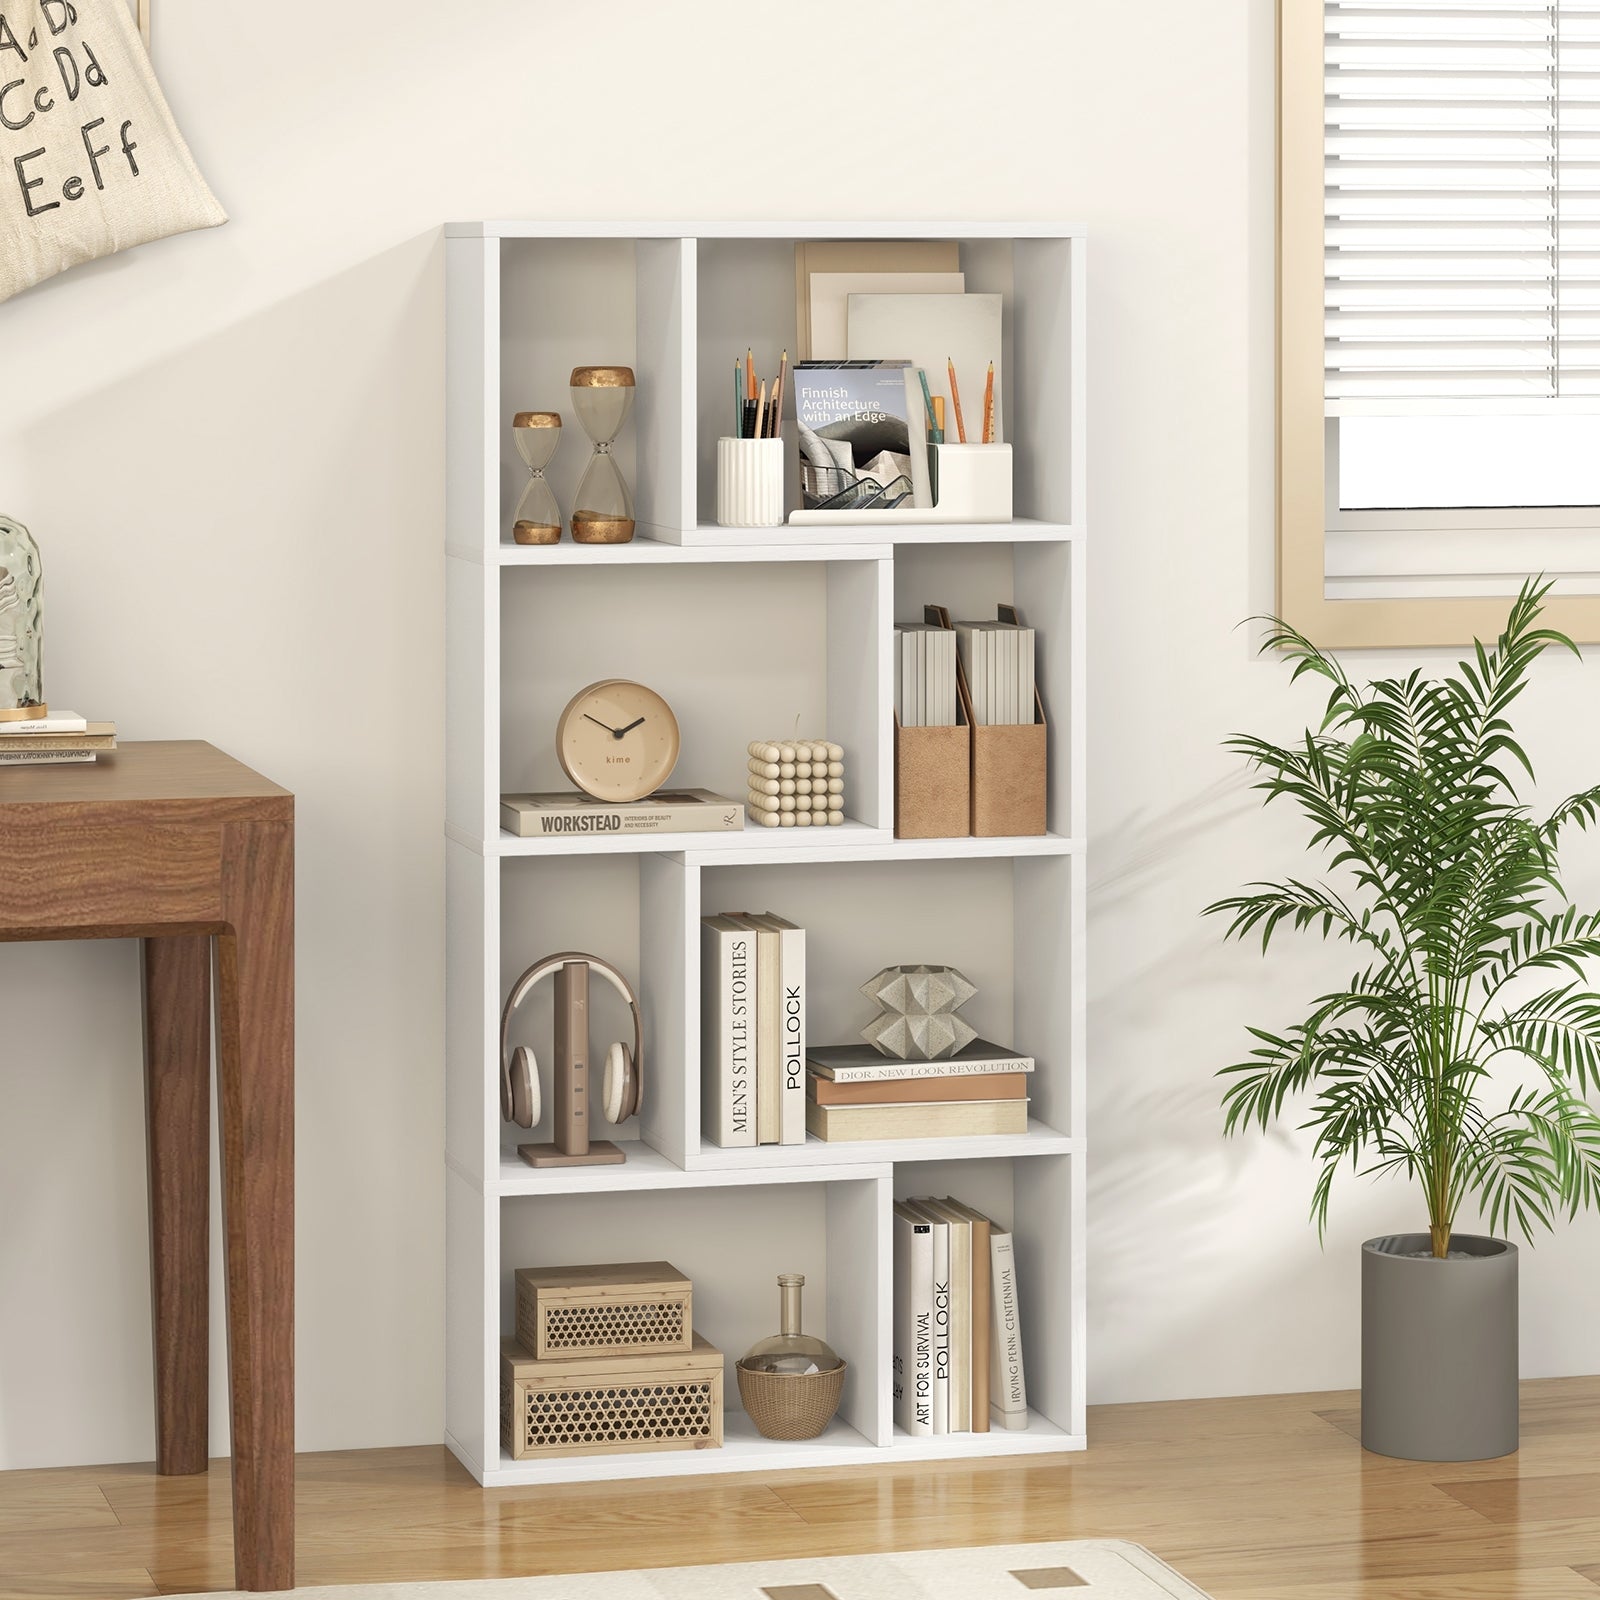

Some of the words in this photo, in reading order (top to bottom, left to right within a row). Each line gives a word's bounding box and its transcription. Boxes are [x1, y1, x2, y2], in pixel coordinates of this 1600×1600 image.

[802, 387, 848, 399] Finnish
[802, 398, 881, 410] Architecture
[803, 410, 831, 422] with
[835, 412, 850, 422] an
[855, 410, 886, 424] Edge
[606, 755, 631, 764] kime
[541, 814, 621, 832] WORKSTEAD
[731, 940, 748, 1017] STORIES
[732, 1019, 748, 1075] STYLE
[786, 985, 801, 1090] POLLOCK
[841, 1070, 875, 1080] DIOR.
[879, 1068, 906, 1078] NEW
[911, 1066, 945, 1076] LOOK
[949, 1061, 1030, 1073] REVOLUTION
[1002, 1268, 1015, 1331] CENTENNIAL
[916, 1311, 930, 1369] SURVIVAL
[935, 1281, 949, 1380] POLLOCK
[1008, 1333, 1018, 1362] PENN:
[916, 1371, 930, 1398] FOR
[1010, 1365, 1021, 1403] IRVING
[916, 1402, 930, 1425] ART
